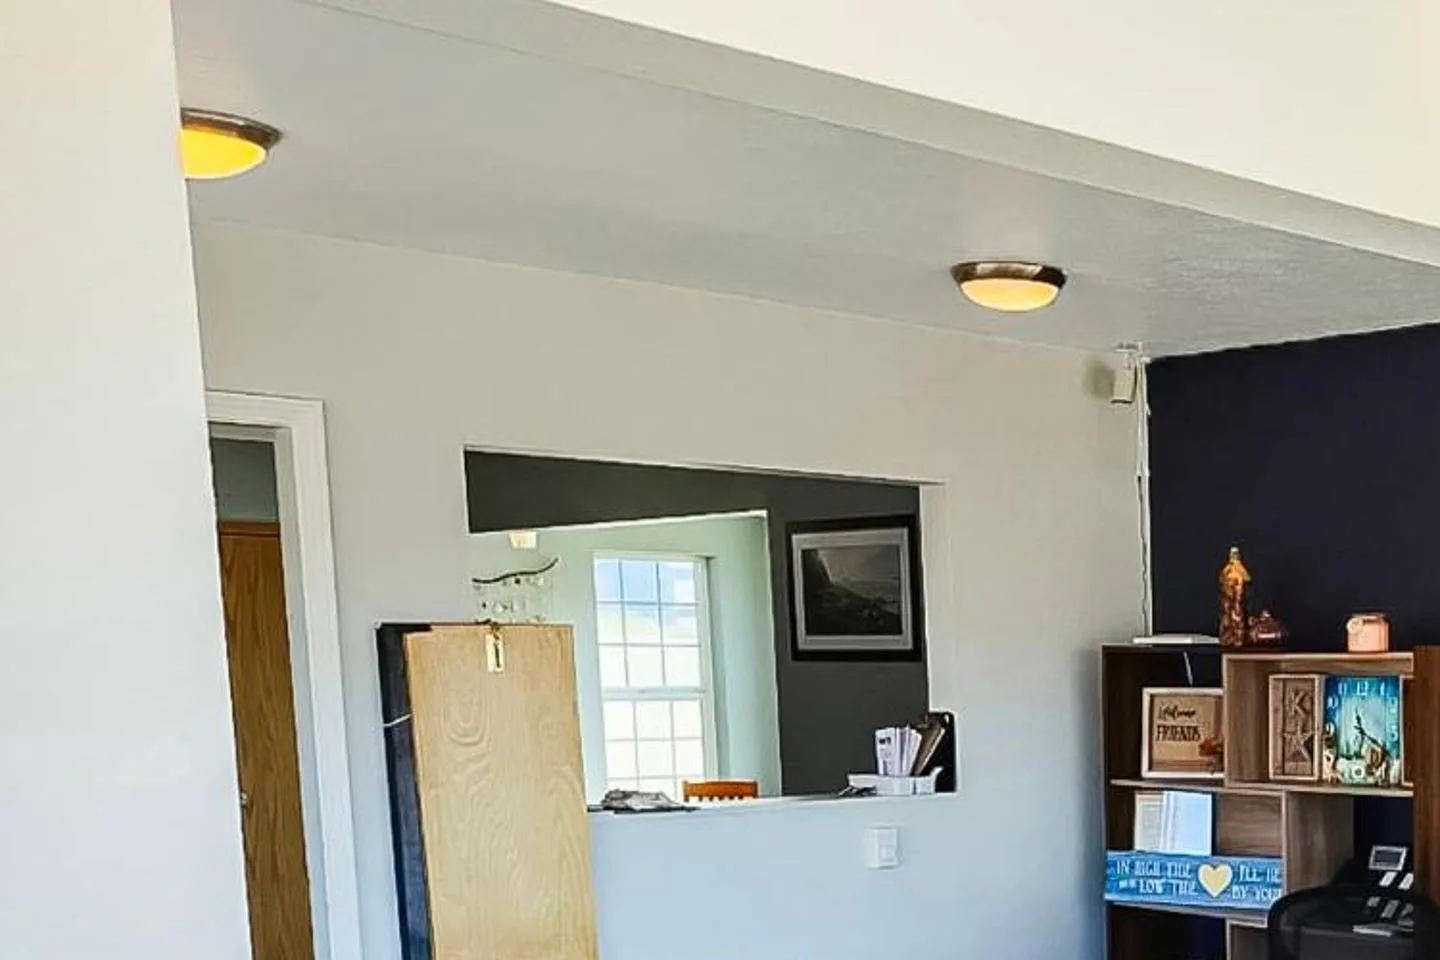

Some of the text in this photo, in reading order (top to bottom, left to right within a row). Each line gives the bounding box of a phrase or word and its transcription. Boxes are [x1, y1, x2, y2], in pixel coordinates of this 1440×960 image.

[1156, 724, 1201, 742] FRIENDS
[1116, 858, 1130, 875] IN
[1140, 878, 1167, 894] LOW
